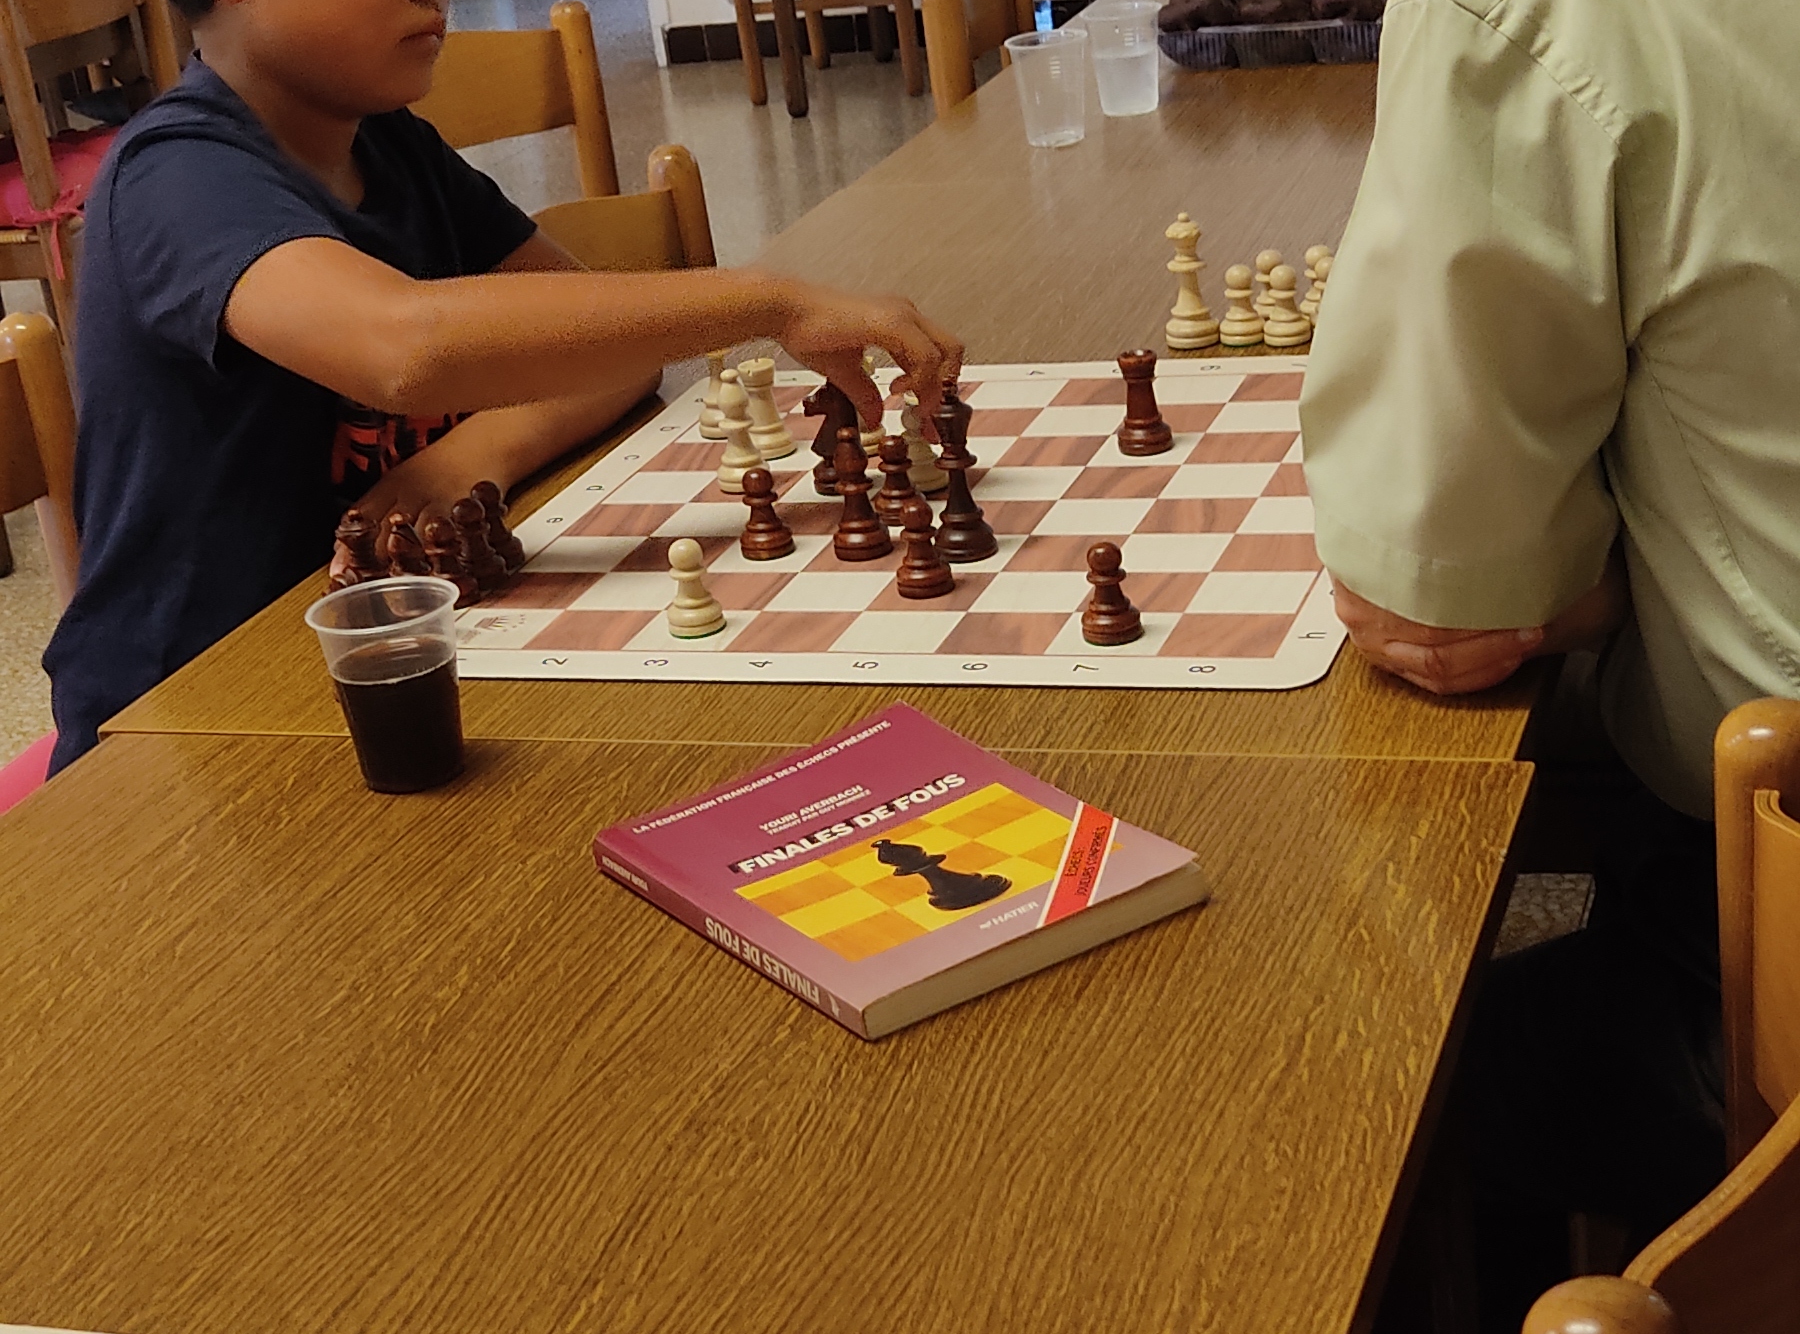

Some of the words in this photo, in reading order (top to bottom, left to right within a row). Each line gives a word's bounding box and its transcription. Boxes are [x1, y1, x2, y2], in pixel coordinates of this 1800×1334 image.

[623, 454, 640, 462] c
[586, 483, 605, 492] d
[546, 516, 563, 525] e
[542, 657, 569, 666] 2
[644, 658, 669, 667] 3
[749, 659, 773, 668] 4
[852, 660, 880, 670] 5
[962, 661, 988, 672] 6
[1072, 663, 1100, 673] 7
[1188, 664, 1216, 675] 8
[632, 824, 650, 835] LA
[649, 799, 717, 830] FÉDÉRATION
[717, 774, 776, 804] FRANÇAISE
[775, 765, 798, 780] DES
[796, 746, 839, 770] ÉCHECS
[837, 720, 892, 750] PRÉSENTE
[759, 813, 798, 832] YOURI
[800, 785, 863, 816] AVERBACH
[738, 822, 854, 874] FINALES
[853, 805, 896, 828] DE
[893, 773, 966, 811] FOUS
[991, 901, 1039, 926] HATIER
[705, 917, 739, 954] FOUS
[742, 940, 760, 965] DE
[763, 958, 820, 1004] FINALES
